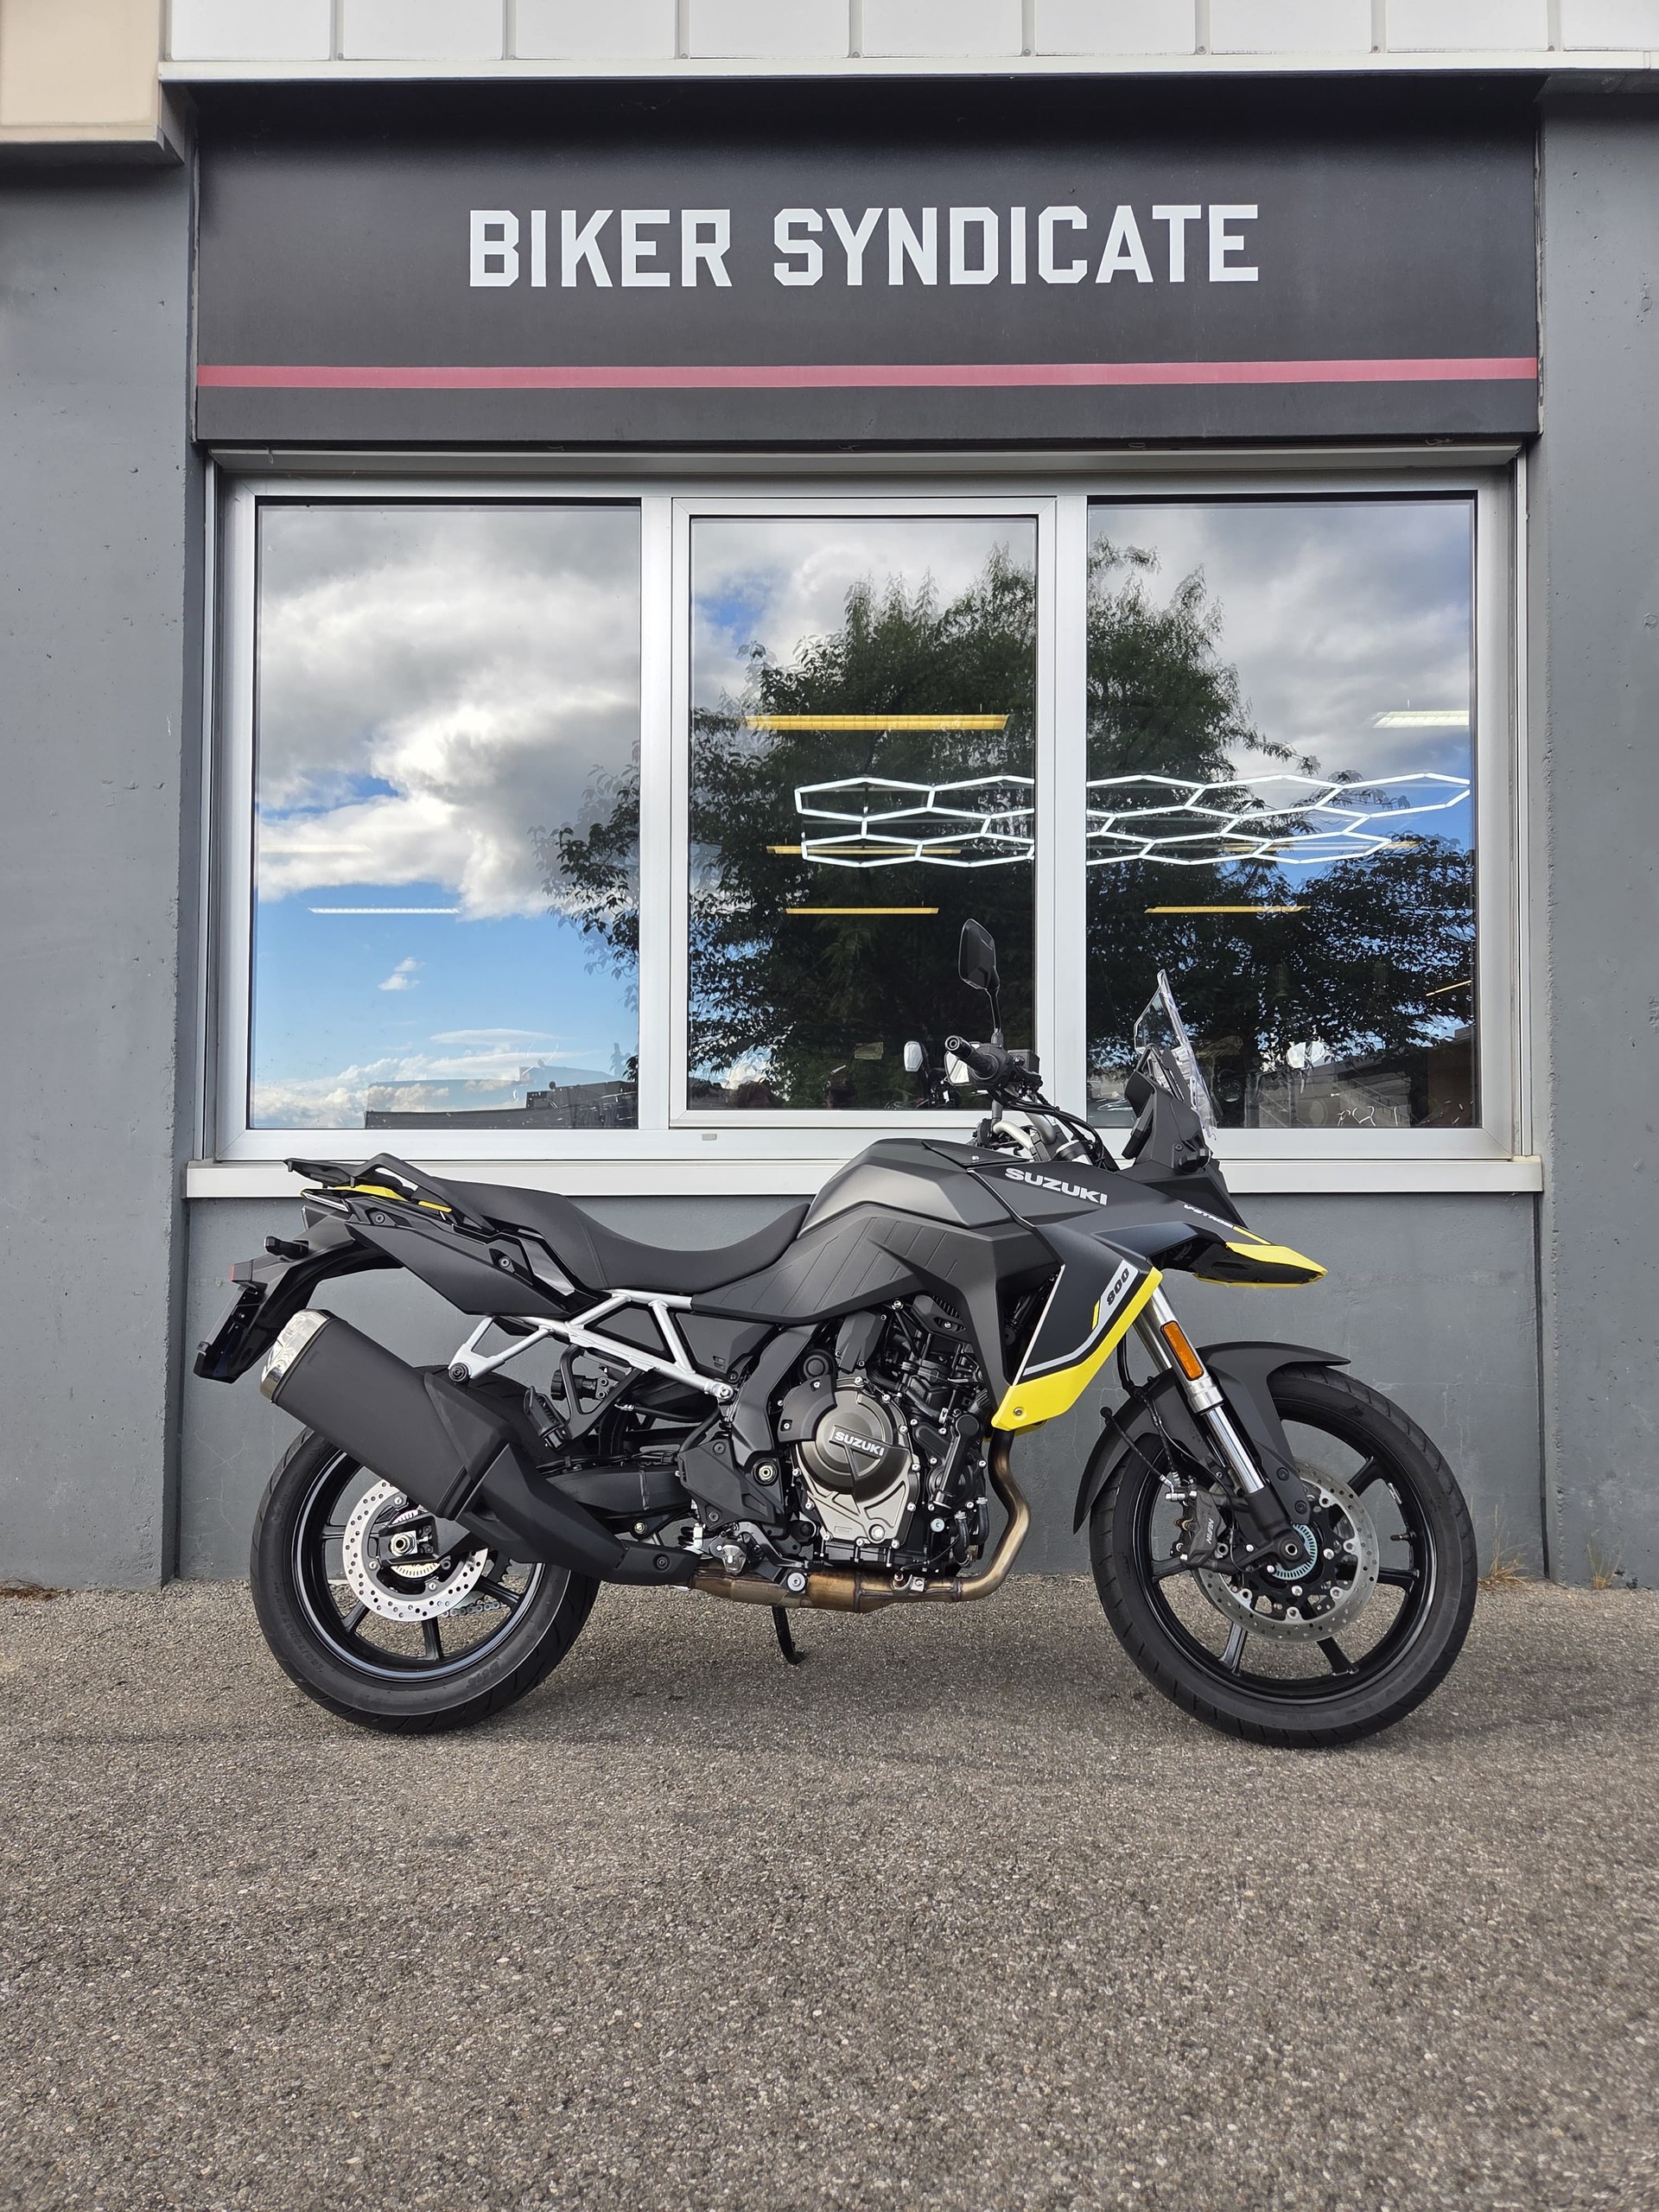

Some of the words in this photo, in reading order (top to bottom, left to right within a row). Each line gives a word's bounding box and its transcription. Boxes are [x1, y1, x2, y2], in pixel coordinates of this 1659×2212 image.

[469, 208, 732, 288] BIKER
[772, 203, 1259, 287] SYNDICATE
[1004, 1166, 1108, 1206] SUZUKI
[1106, 1268, 1129, 1306] 800
[834, 1430, 885, 1457] SUZUKI
